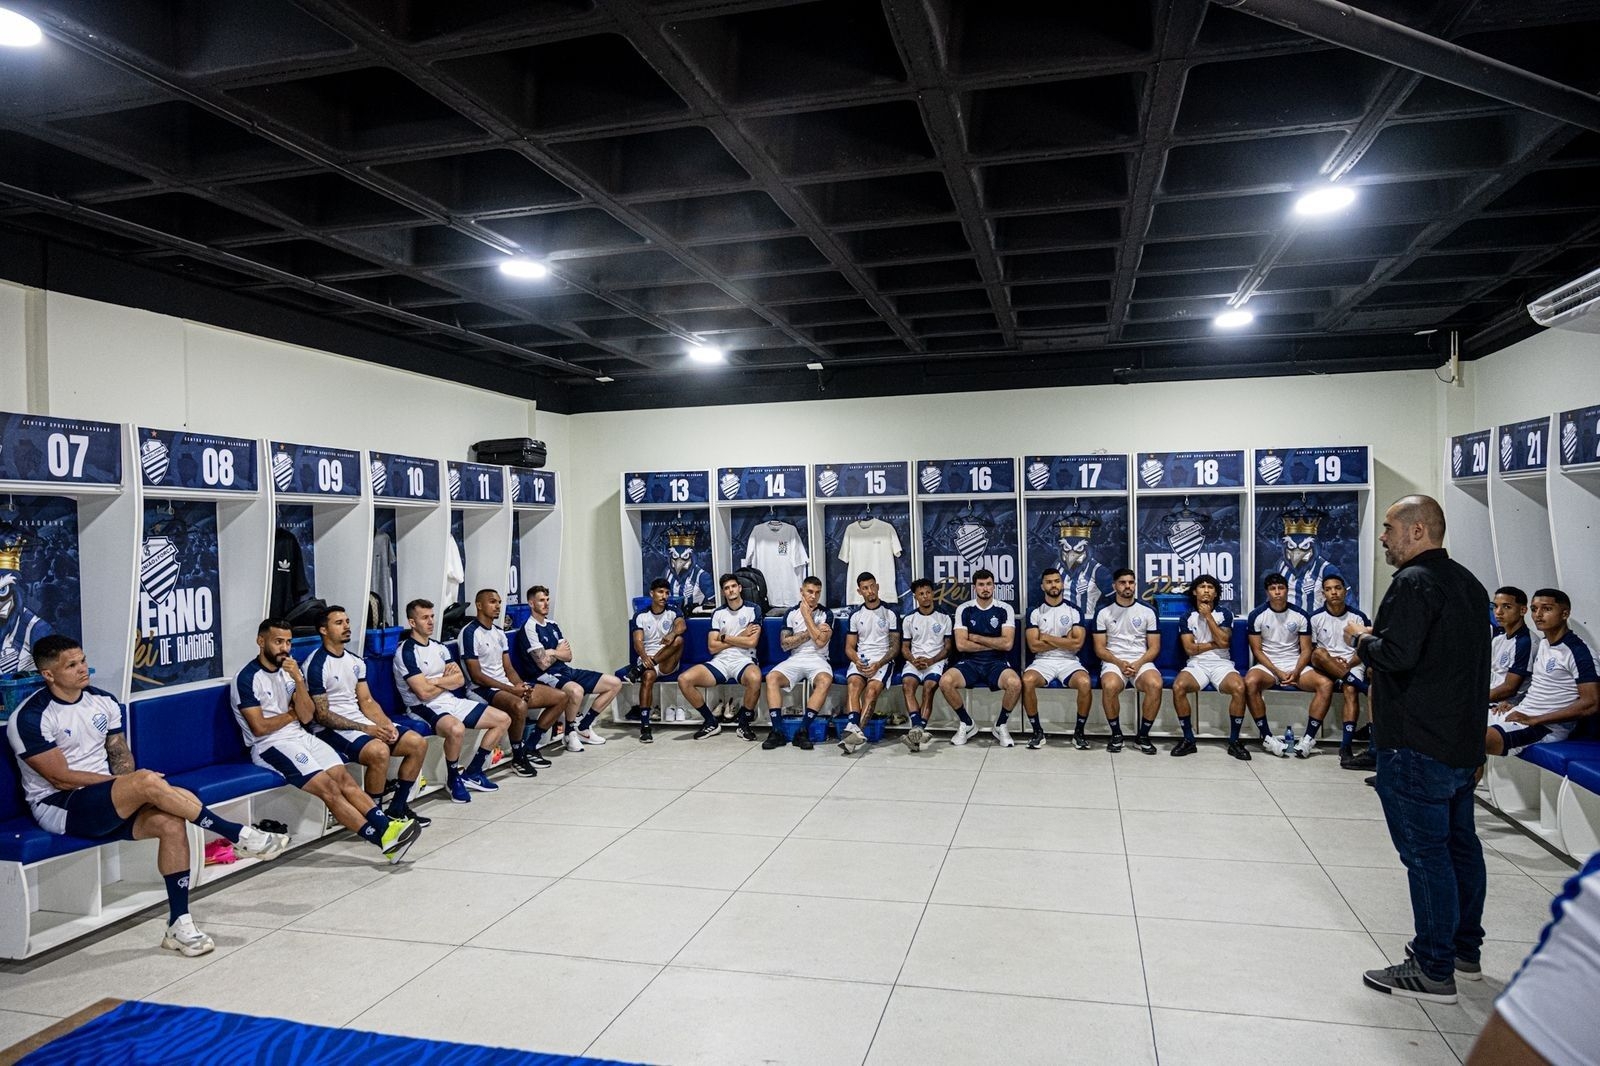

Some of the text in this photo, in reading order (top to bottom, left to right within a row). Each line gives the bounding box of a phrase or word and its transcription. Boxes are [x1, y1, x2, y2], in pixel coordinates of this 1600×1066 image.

[48, 432, 89, 478] 07
[1472, 441, 1486, 472] 20
[1527, 430, 1540, 466] 21
[202, 448, 234, 486] 08
[318, 458, 342, 492] 09
[407, 466, 424, 496] 10
[864, 470, 886, 494] 15
[969, 466, 992, 491] 16
[1078, 463, 1102, 488] 17
[1194, 460, 1219, 486] 18
[1314, 456, 1341, 482] 19
[478, 474, 490, 500] 11
[534, 478, 546, 502] 12
[670, 478, 690, 502] 13
[764, 474, 786, 497] 14
[934, 554, 1014, 584] ETERNO
[1145, 552, 1233, 582] ETERNO
[140, 586, 213, 638] ERNO
[160, 638, 172, 666] DE
[177, 632, 214, 662] ALAGOAS
